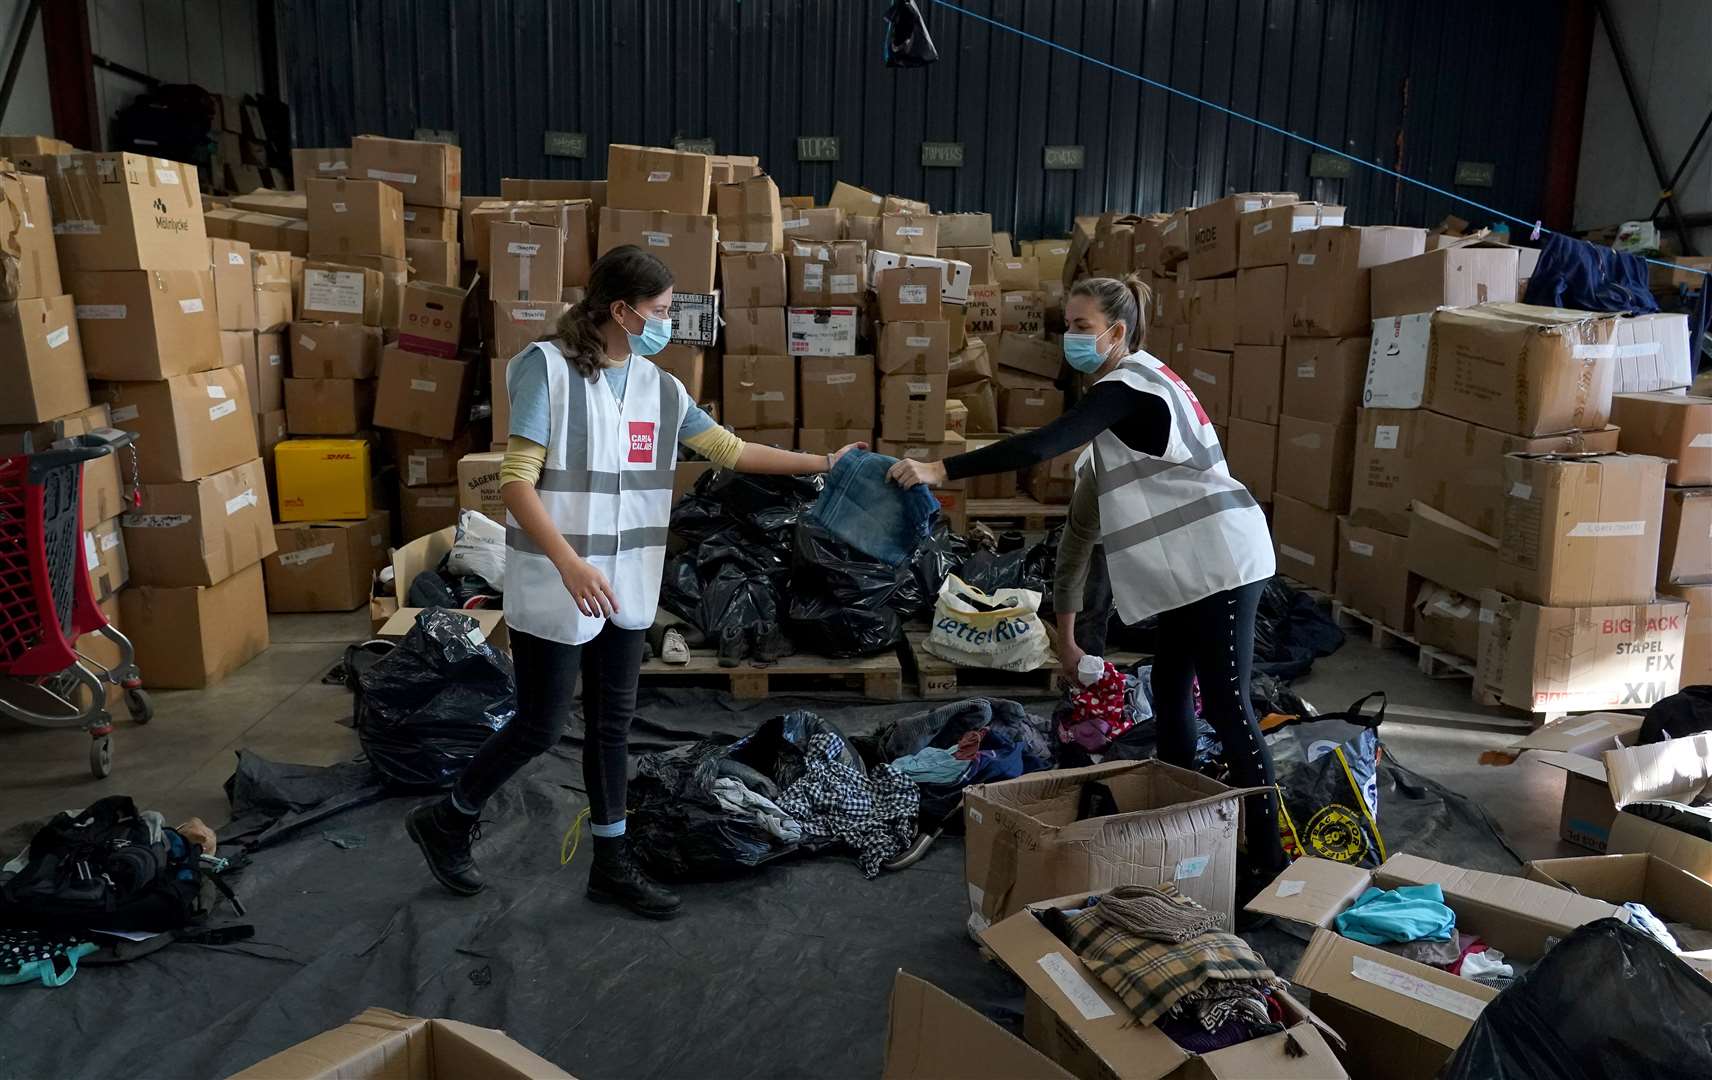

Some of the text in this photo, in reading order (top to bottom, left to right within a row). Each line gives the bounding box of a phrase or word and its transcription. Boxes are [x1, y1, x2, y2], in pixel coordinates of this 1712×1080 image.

[799, 138, 837, 158] TOPS
[980, 308, 997, 317] FIX
[972, 320, 994, 332] XM
[1019, 322, 1038, 332] XM
[1602, 618, 1632, 634] BIG
[1616, 641, 1663, 655] STAPEL
[1645, 654, 1675, 672] FIX
[1621, 682, 1666, 704] XM
[1311, 816, 1331, 842] BAG
[1347, 820, 1360, 846] FOR
